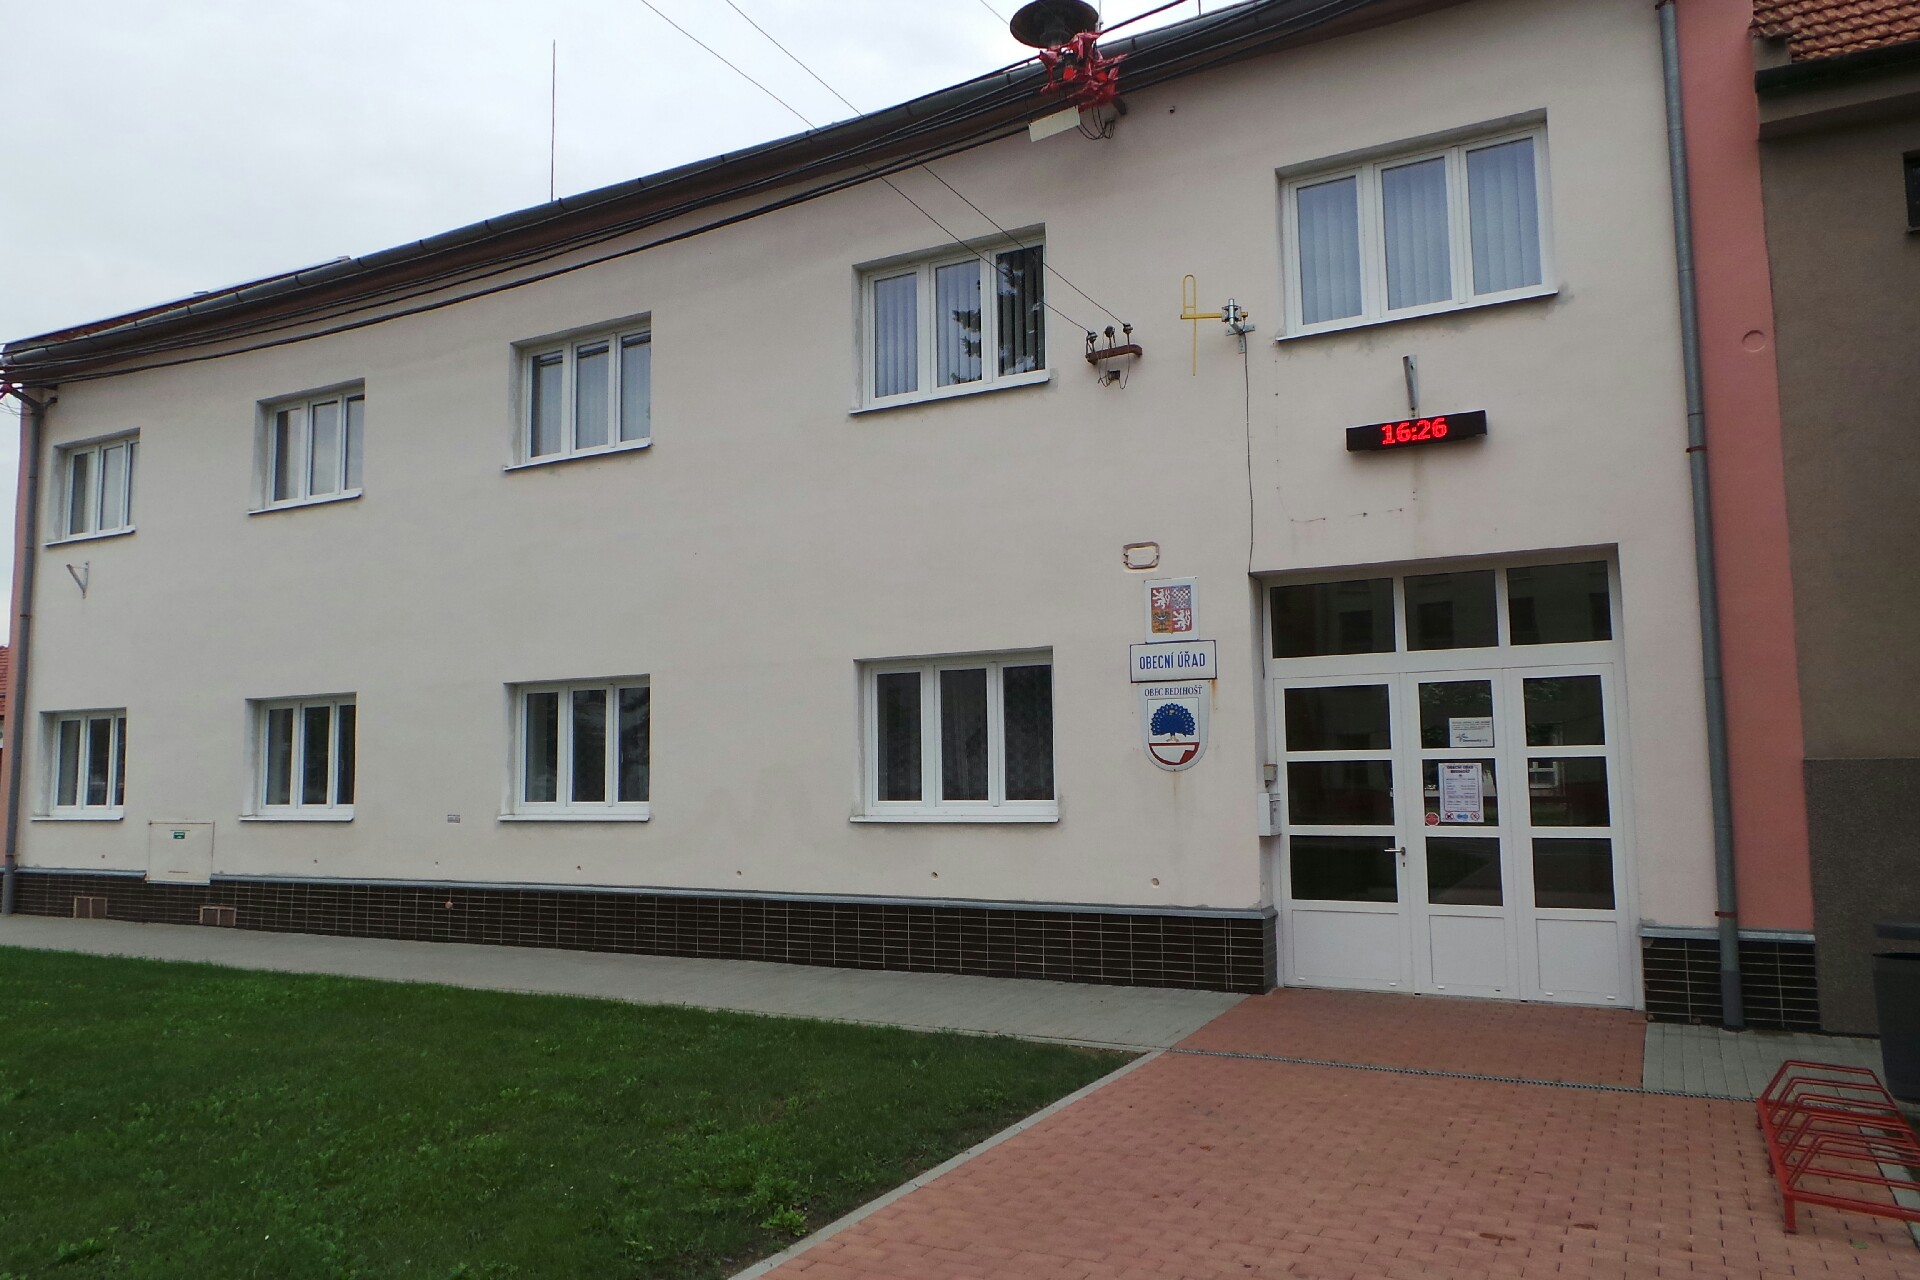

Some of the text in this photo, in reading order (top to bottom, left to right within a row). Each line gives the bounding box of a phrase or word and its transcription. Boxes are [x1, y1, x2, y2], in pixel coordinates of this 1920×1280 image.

[1381, 417, 1448, 445] 16:26
[1139, 651, 1206, 670] OBECNÍ ÚŘAD
[1144, 687, 1163, 697] OBEC
